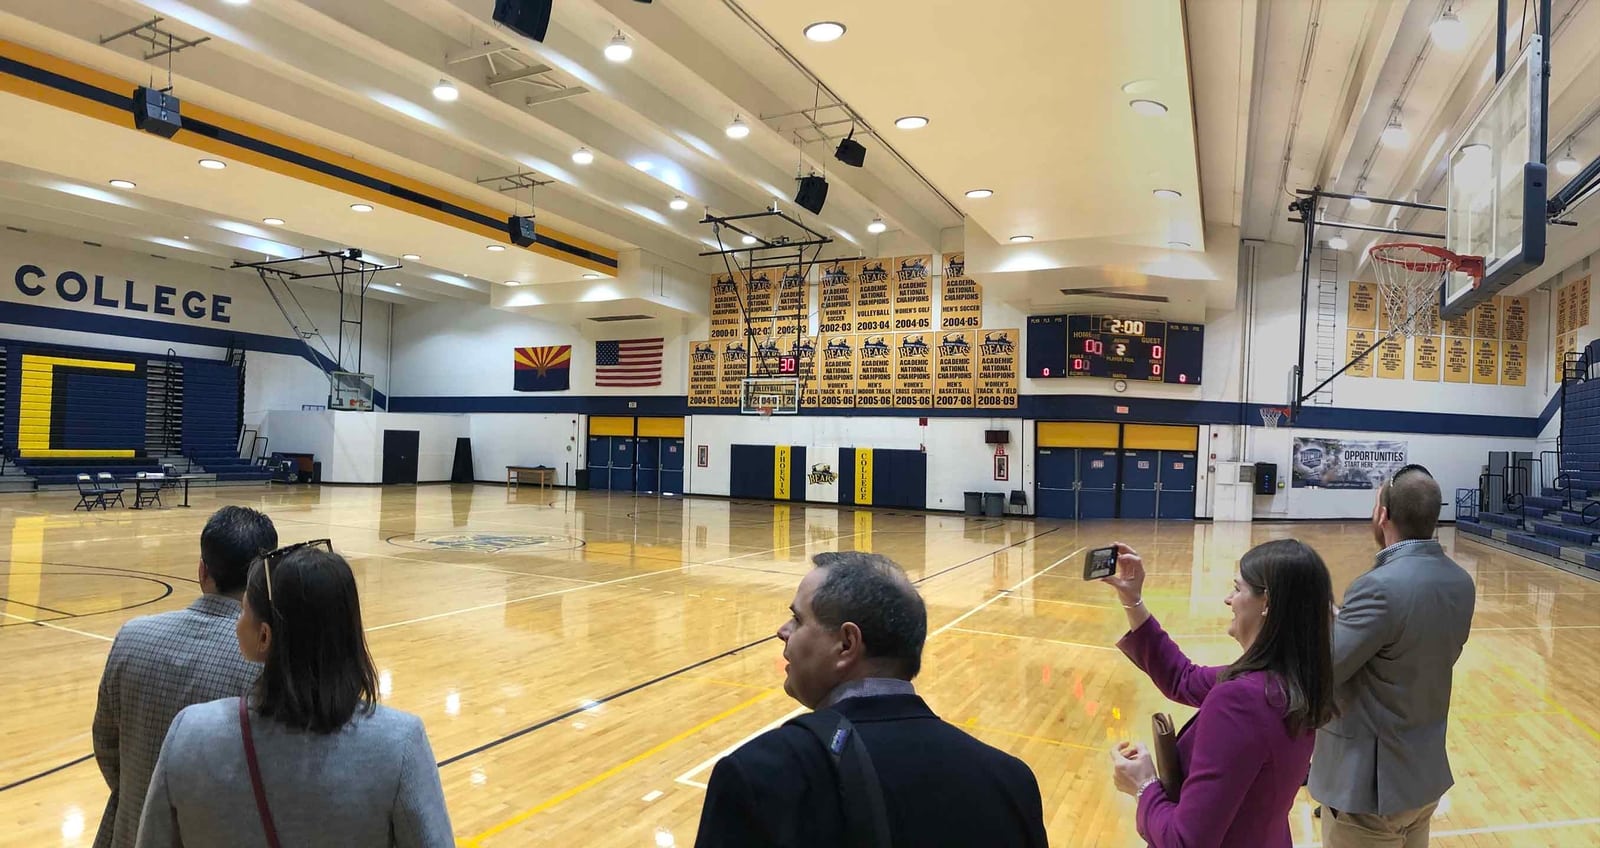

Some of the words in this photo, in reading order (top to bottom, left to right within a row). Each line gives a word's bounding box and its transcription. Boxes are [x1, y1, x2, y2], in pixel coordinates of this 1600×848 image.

[896, 268, 928, 282] BEARS
[945, 266, 964, 279] BEA
[858, 274, 889, 285] BEARS
[15, 265, 231, 323] COLLEGE
[948, 286, 976, 294] NATIONAL
[858, 298, 889, 306] CHAMPIONS
[858, 321, 890, 331] 2003-04
[896, 318, 930, 328] 2004-05
[944, 317, 978, 327] 2004-05
[1111, 320, 1144, 334] 2:00
[712, 329, 738, 337] 2000-01
[744, 327, 771, 335] 202-03
[820, 323, 852, 333] 2002-03
[823, 349, 852, 360] BEARS
[860, 348, 890, 359] BEARS
[898, 347, 929, 358] BEARS
[938, 346, 970, 357] BEARS
[979, 344, 1015, 356] BEARS
[1152, 346, 1162, 358] 0
[780, 358, 794, 372] 30
[1152, 364, 1160, 374] 0
[1043, 368, 1050, 376] 0
[690, 396, 716, 404] 2004-05
[822, 396, 852, 404] 2005-06
[858, 396, 890, 404] 2005-06
[896, 396, 930, 404] 2005-06
[936, 396, 972, 405] 2007-08
[978, 396, 1014, 405] 2008-09
[1344, 450, 1404, 462] OPPORTUNITIES
[808, 474, 837, 485] BEARS
